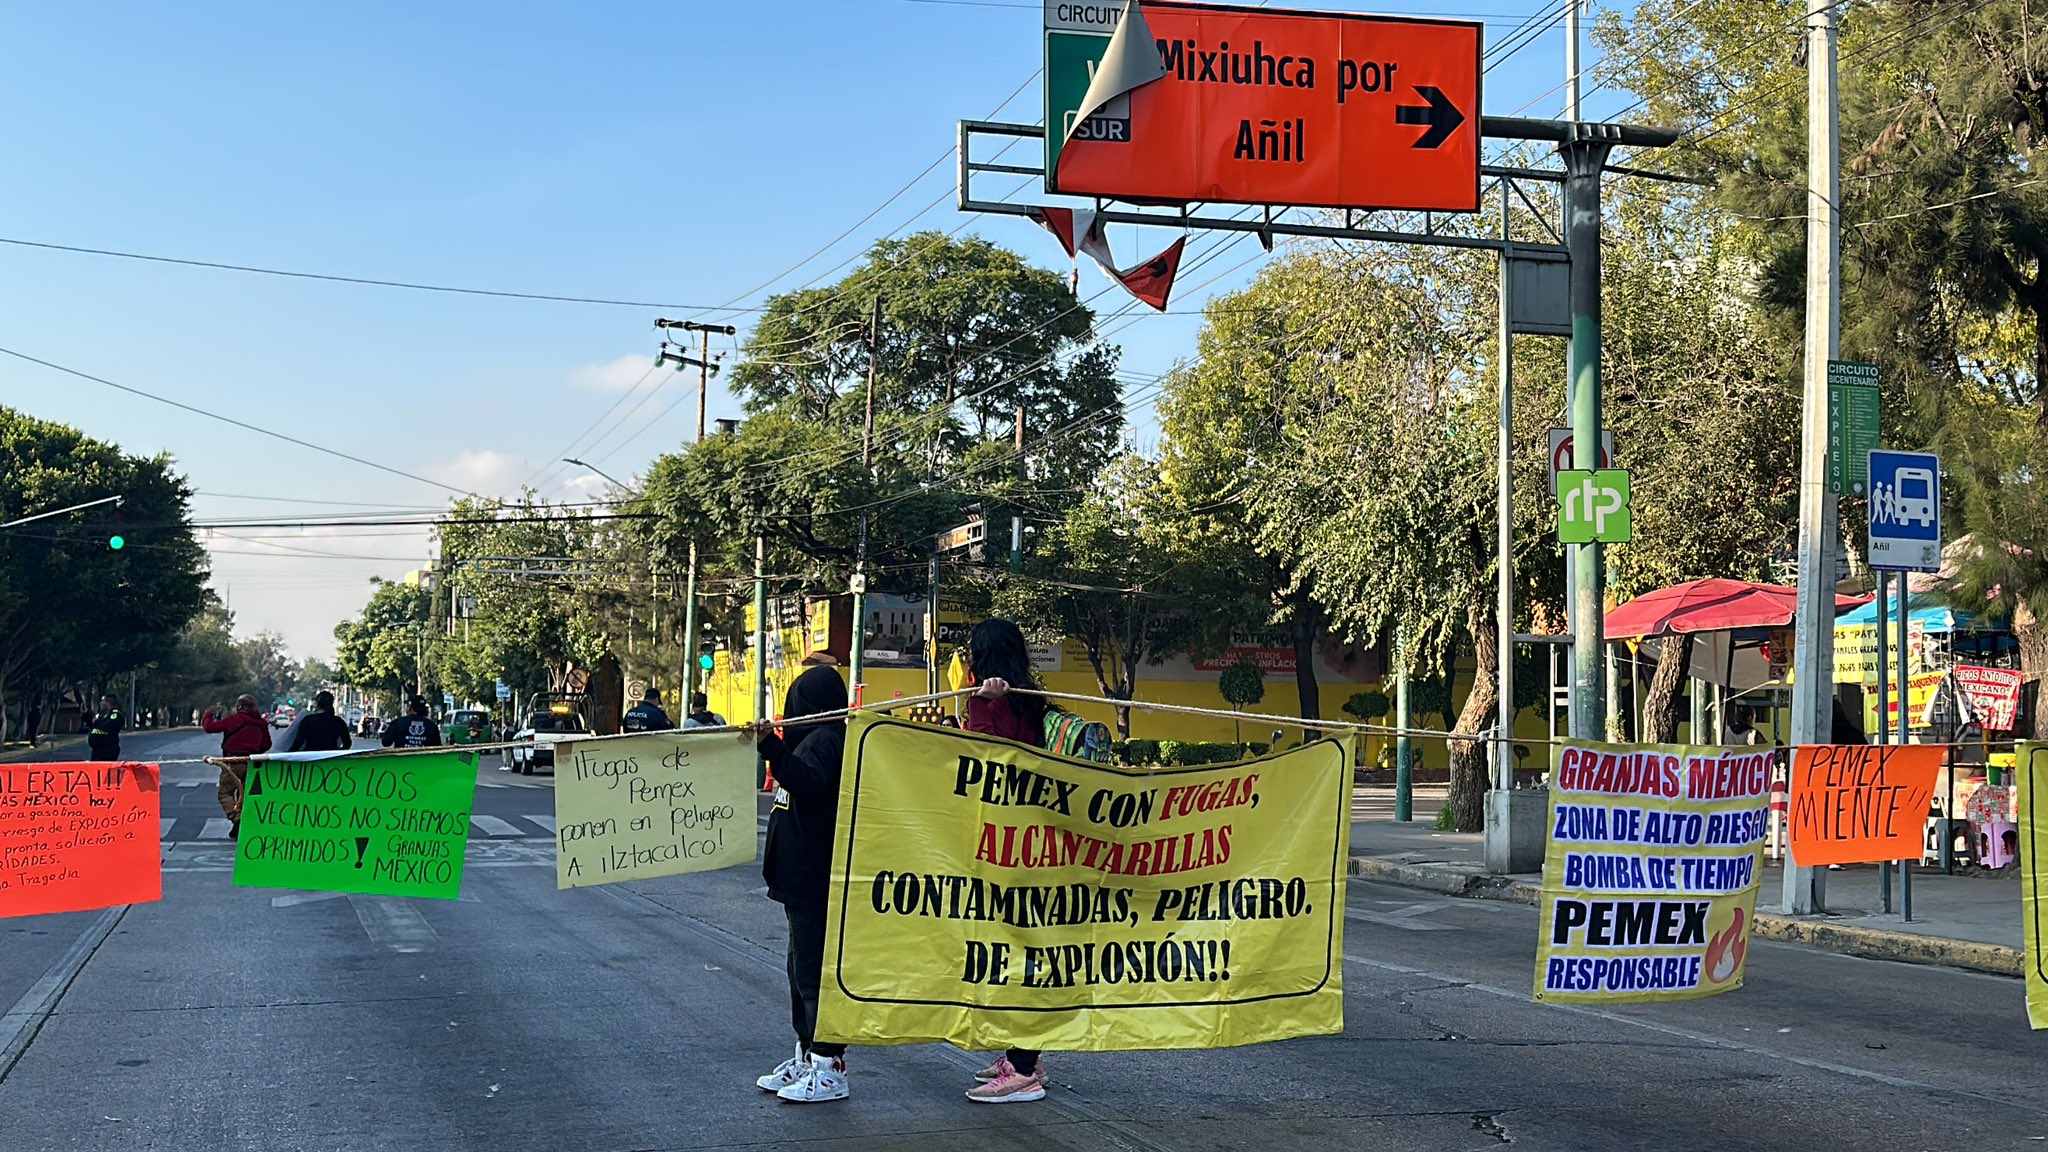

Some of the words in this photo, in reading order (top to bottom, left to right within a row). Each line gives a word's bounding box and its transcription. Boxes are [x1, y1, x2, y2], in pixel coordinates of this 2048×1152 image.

[1057, 4, 1125, 25] CIRCUIT
[1156, 39, 1315, 89] Mixiuhca
[1337, 59, 1398, 104] por
[1077, 120, 1124, 140] SUR
[1233, 118, 1305, 163] Añil
[1828, 363, 1879, 376] CIRCUITO
[1828, 374, 1879, 387] BICENTENARIO
[1565, 479, 1622, 534] rtp
[1872, 541, 1890, 551] Añil
[661, 746, 691, 771] de
[1559, 750, 1680, 797] GRANJAS
[1688, 752, 1775, 800] MÉXICO
[1808, 745, 1899, 787] PEMEX
[365, 767, 418, 802] LOS
[629, 776, 696, 807] Pemex
[953, 754, 1079, 816] PEMEX
[1088, 786, 1158, 828] CON
[1159, 773, 1261, 821] FUGAS,
[49, 821, 63, 833] de
[253, 800, 343, 830] VECINOS
[349, 806, 382, 830] NO
[1554, 806, 1608, 839] ZONA
[1613, 808, 1641, 841] DE
[1643, 811, 1703, 844] ALTO
[1705, 807, 1769, 844] RIESGO
[387, 834, 450, 859] GRANJAS
[560, 817, 617, 853] ponen
[629, 815, 652, 832] en
[975, 822, 1233, 876] ALCANTARILLAS
[17, 867, 81, 887] Tragedia
[567, 856, 583, 877] A
[1565, 854, 1647, 888] BOMBA
[1649, 857, 1677, 889] DE
[1681, 854, 1754, 890] TIEMPO
[871, 869, 1140, 929] CONTAMINADAS,
[1151, 876, 1314, 923] PELIGRO.
[1552, 900, 1712, 946] PEMEX
[962, 940, 1010, 986] DE
[1020, 932, 1232, 989] EXPLOSIÓN!!
[1547, 956, 1701, 991] RESPONSABLE
